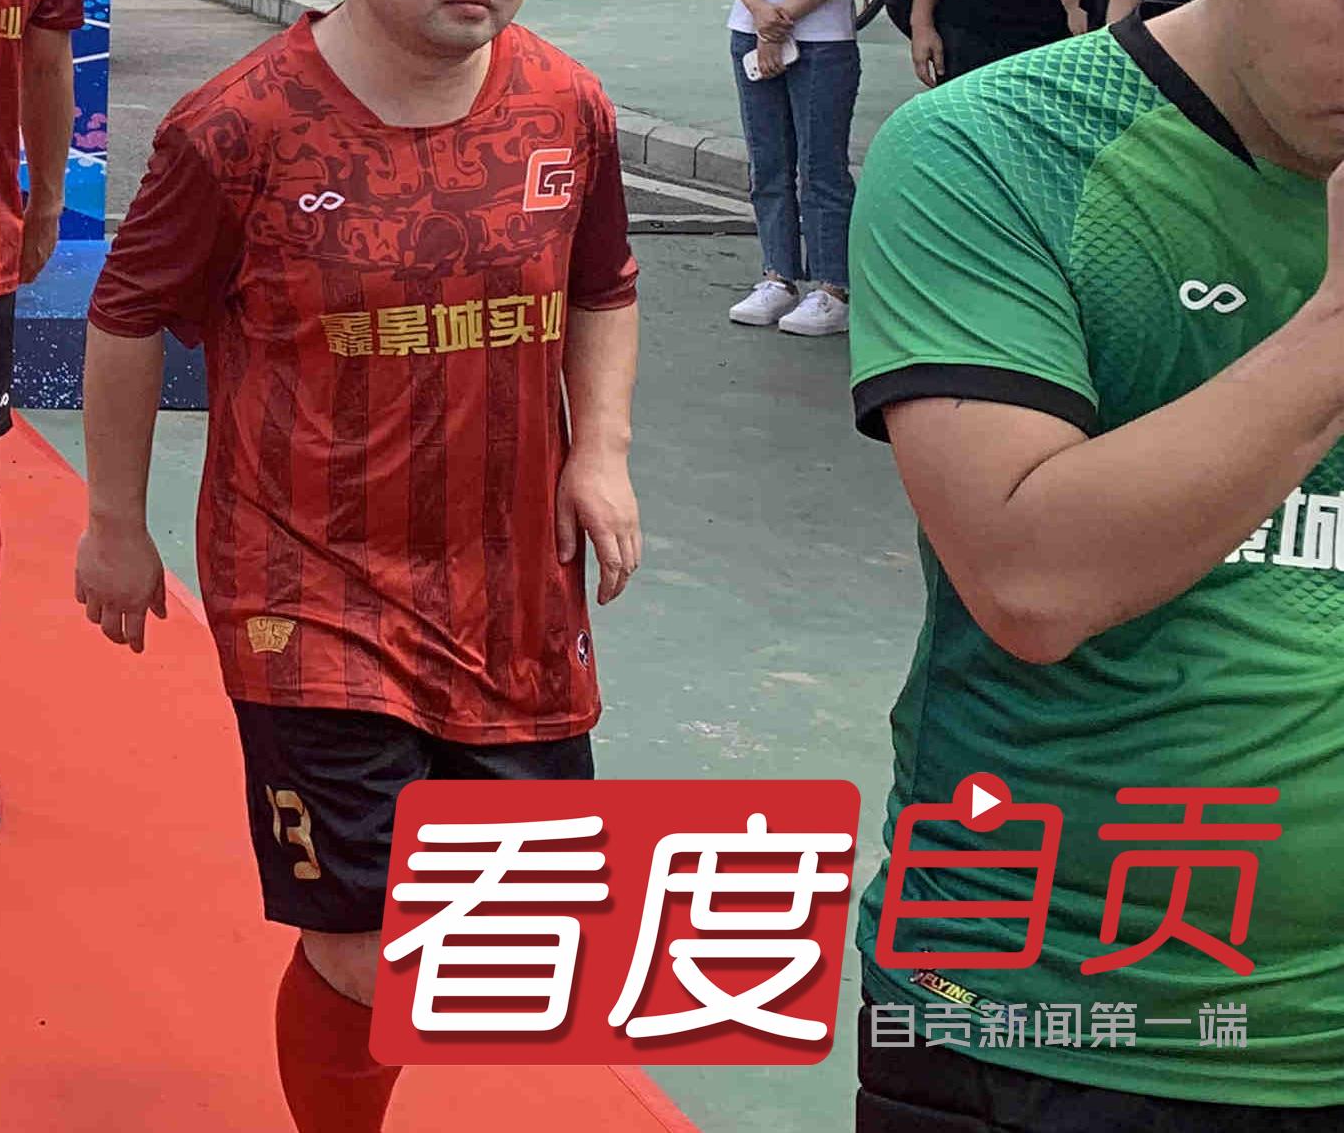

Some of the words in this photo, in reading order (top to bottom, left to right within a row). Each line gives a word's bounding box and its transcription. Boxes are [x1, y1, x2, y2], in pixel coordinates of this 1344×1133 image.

[319, 291, 565, 357] 鑫景城实业
[920, 972, 977, 1004] FLYING
